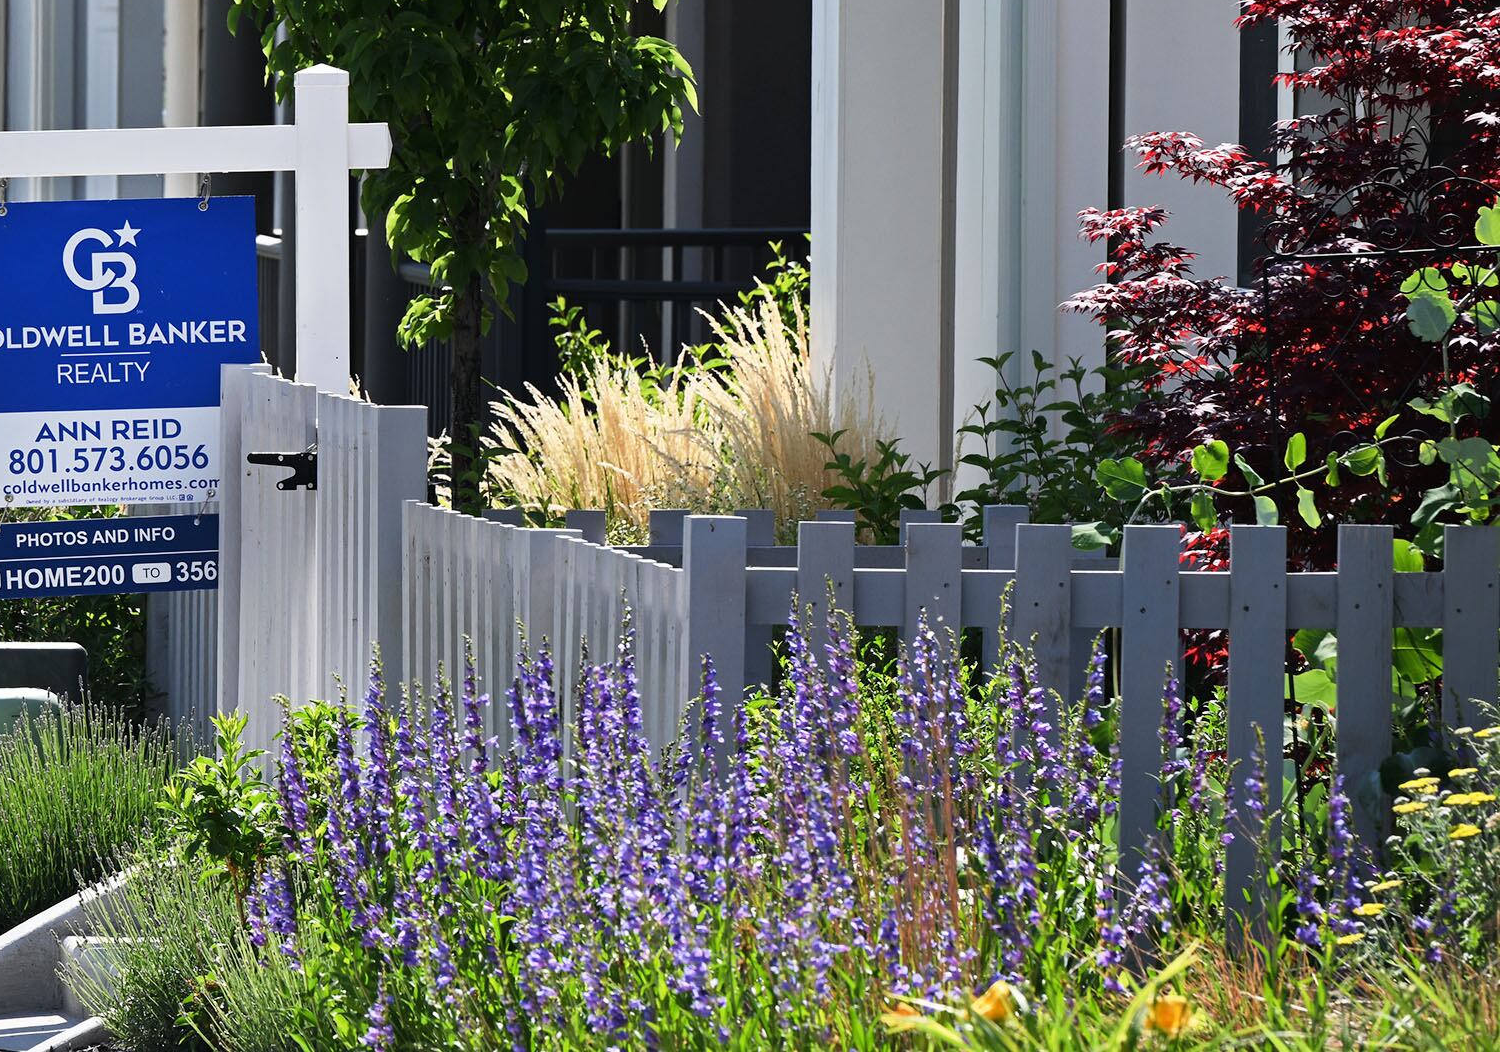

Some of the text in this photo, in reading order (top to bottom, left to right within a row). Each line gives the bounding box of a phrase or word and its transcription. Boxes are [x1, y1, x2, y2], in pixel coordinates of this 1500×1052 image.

[129, 320, 247, 346] BANKER
[57, 361, 151, 384] REALTY
[35, 418, 182, 442] ANN REID
[8, 444, 209, 474] 801.573.6056
[16, 527, 175, 547] PHOTOS AND INFO
[6, 564, 125, 589] HOME200
[142, 567, 161, 579] TO
[176, 560, 217, 582] 356
